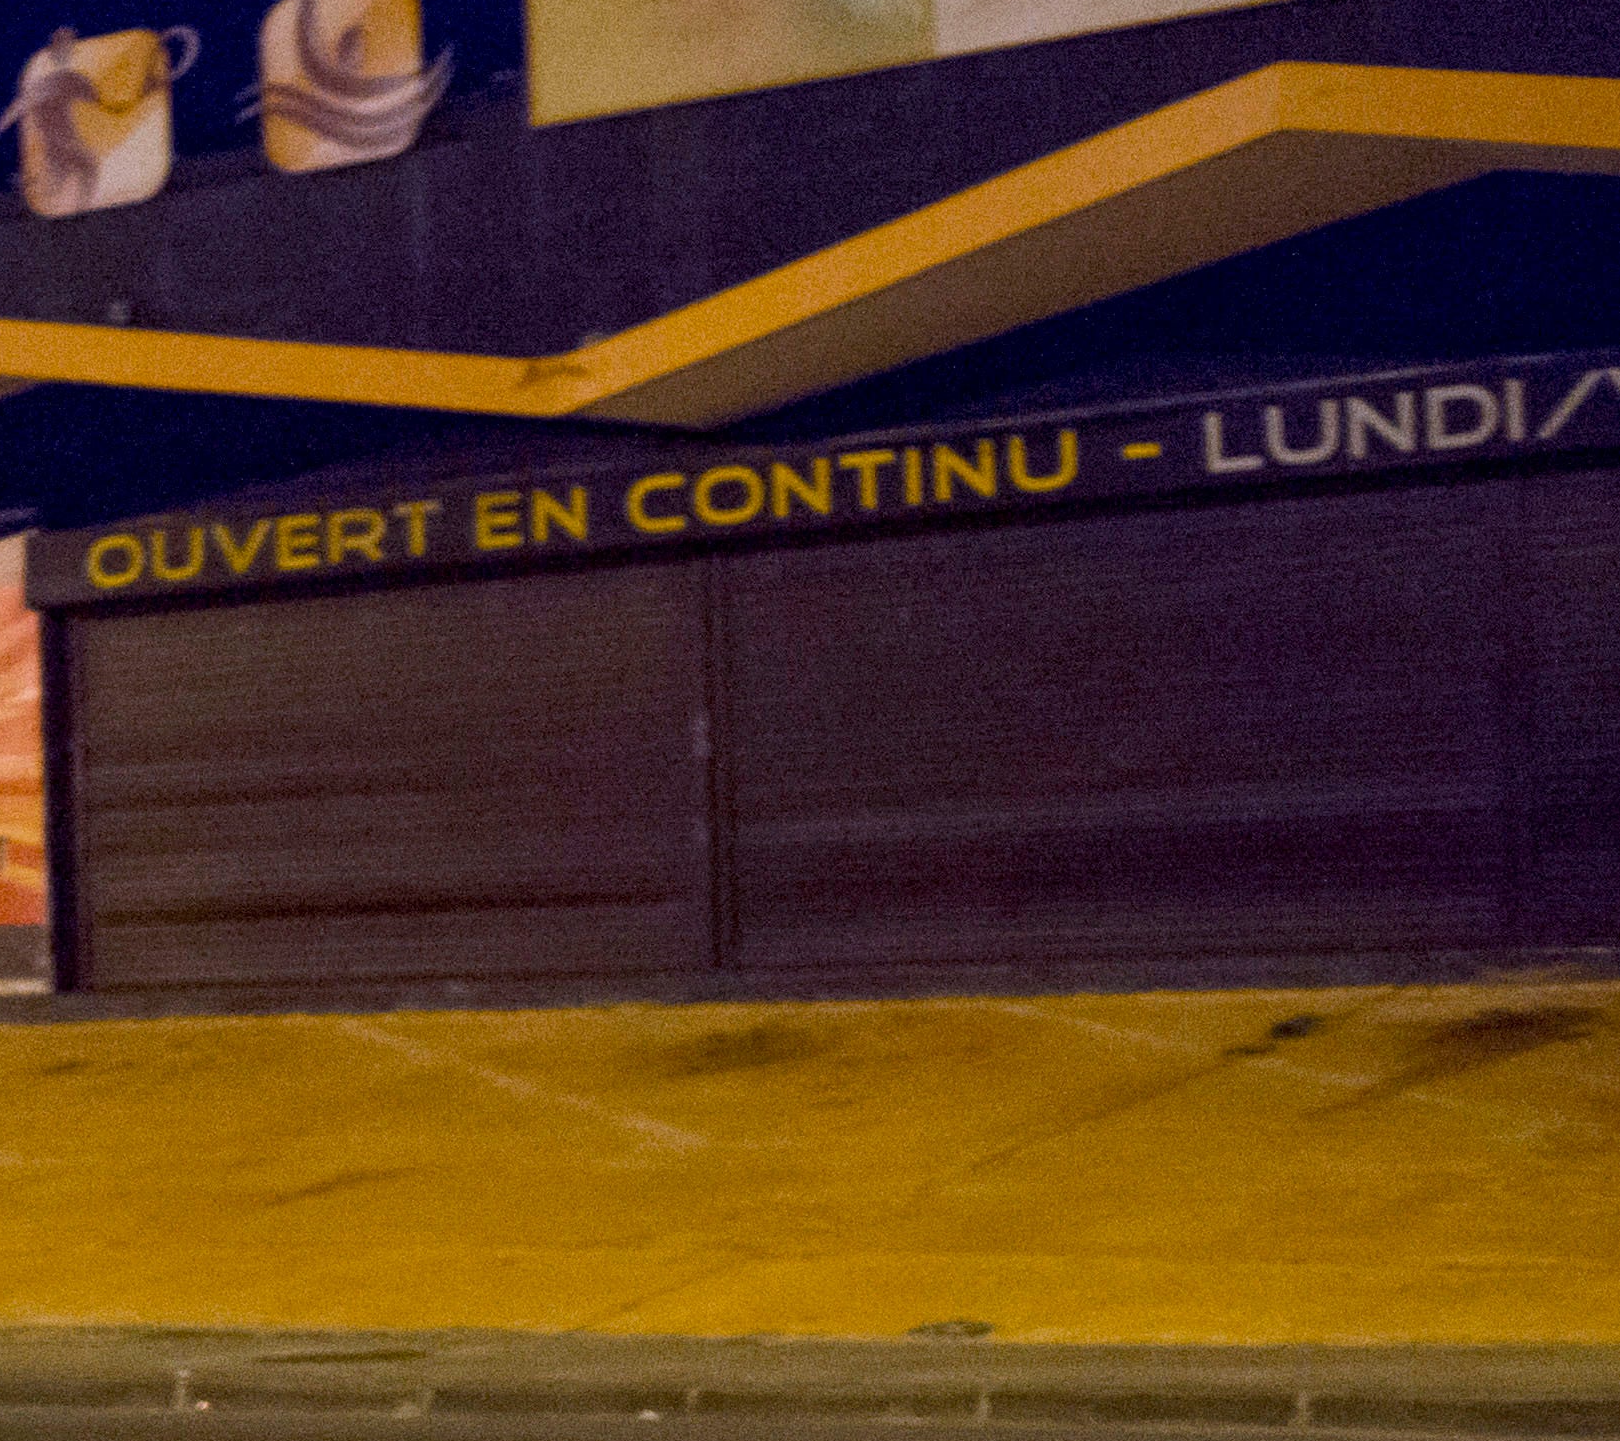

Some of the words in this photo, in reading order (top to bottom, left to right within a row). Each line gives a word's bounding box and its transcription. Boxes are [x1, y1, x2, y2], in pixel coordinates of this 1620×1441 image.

[87, 500, 439, 589] OUVERT
[474, 486, 588, 550] EN
[627, 429, 1078, 533] CONTINU
[1203, 367, 1620, 473] LUNDI/
